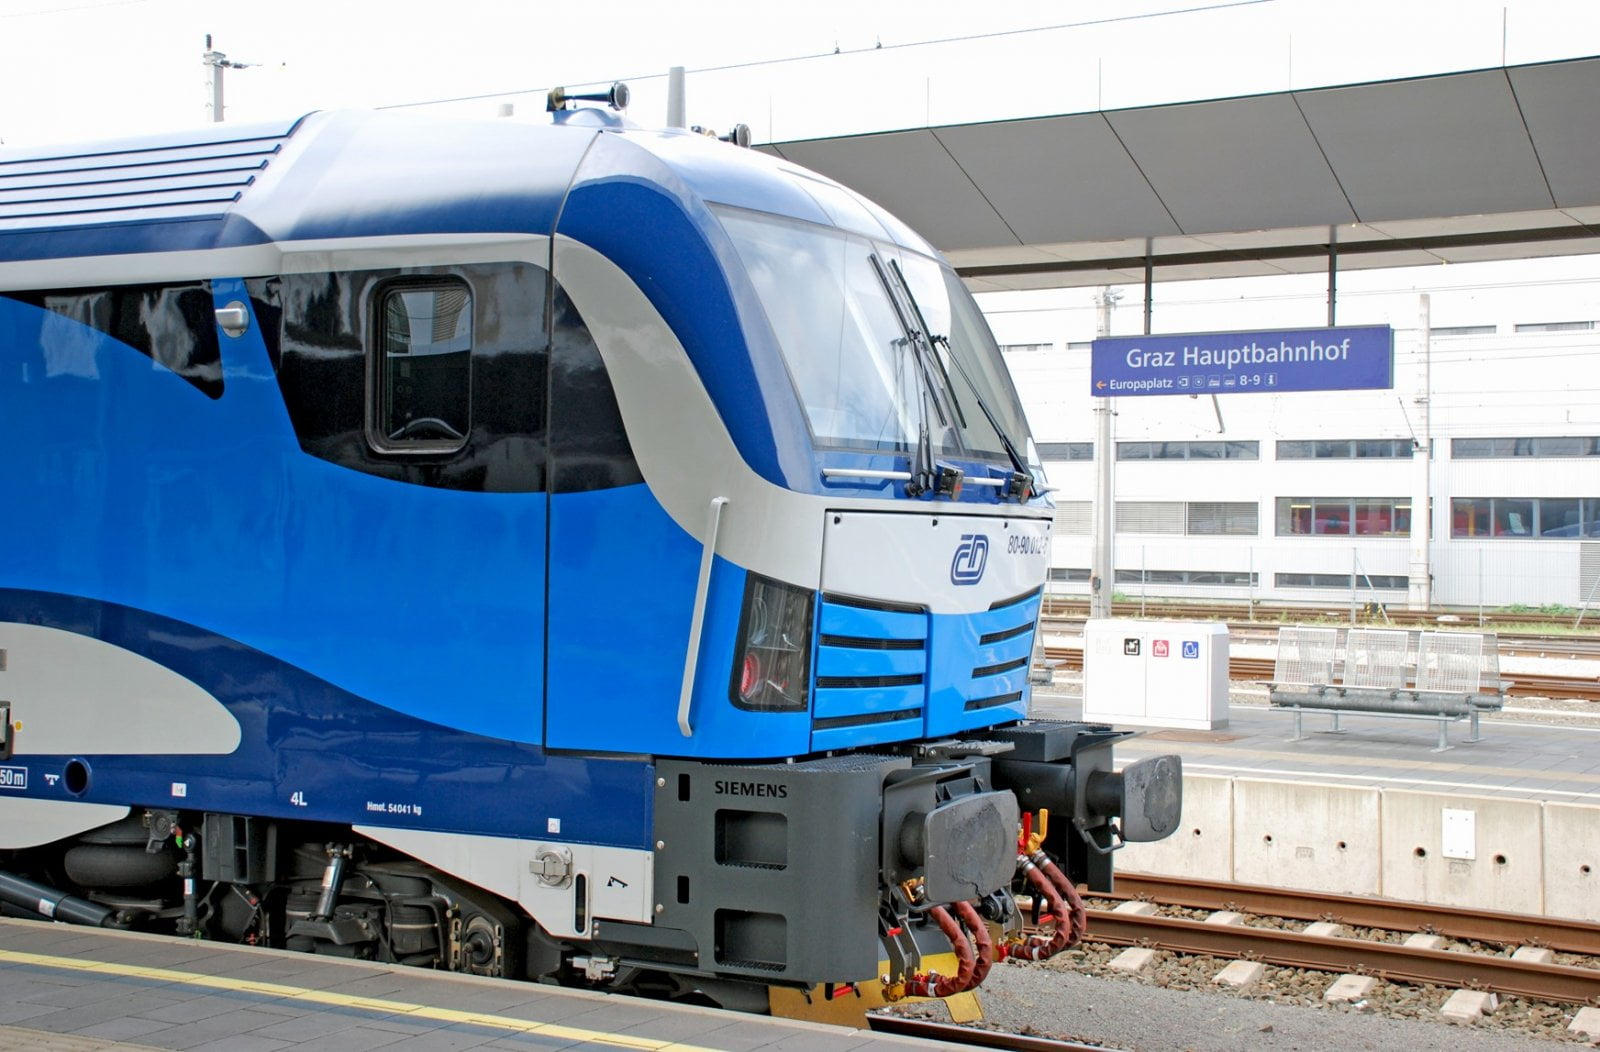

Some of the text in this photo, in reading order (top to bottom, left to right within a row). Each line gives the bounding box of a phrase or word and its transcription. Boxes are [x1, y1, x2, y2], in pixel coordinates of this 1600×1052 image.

[1126, 338, 1350, 370] Graz Hauptbahnhof
[1109, 374, 1261, 392] Europaplatz 8-9
[290, 791, 308, 806] 4L
[714, 780, 788, 799] SIEMENS
[388, 802, 411, 814] 54041
[413, 803, 422, 816] kg
